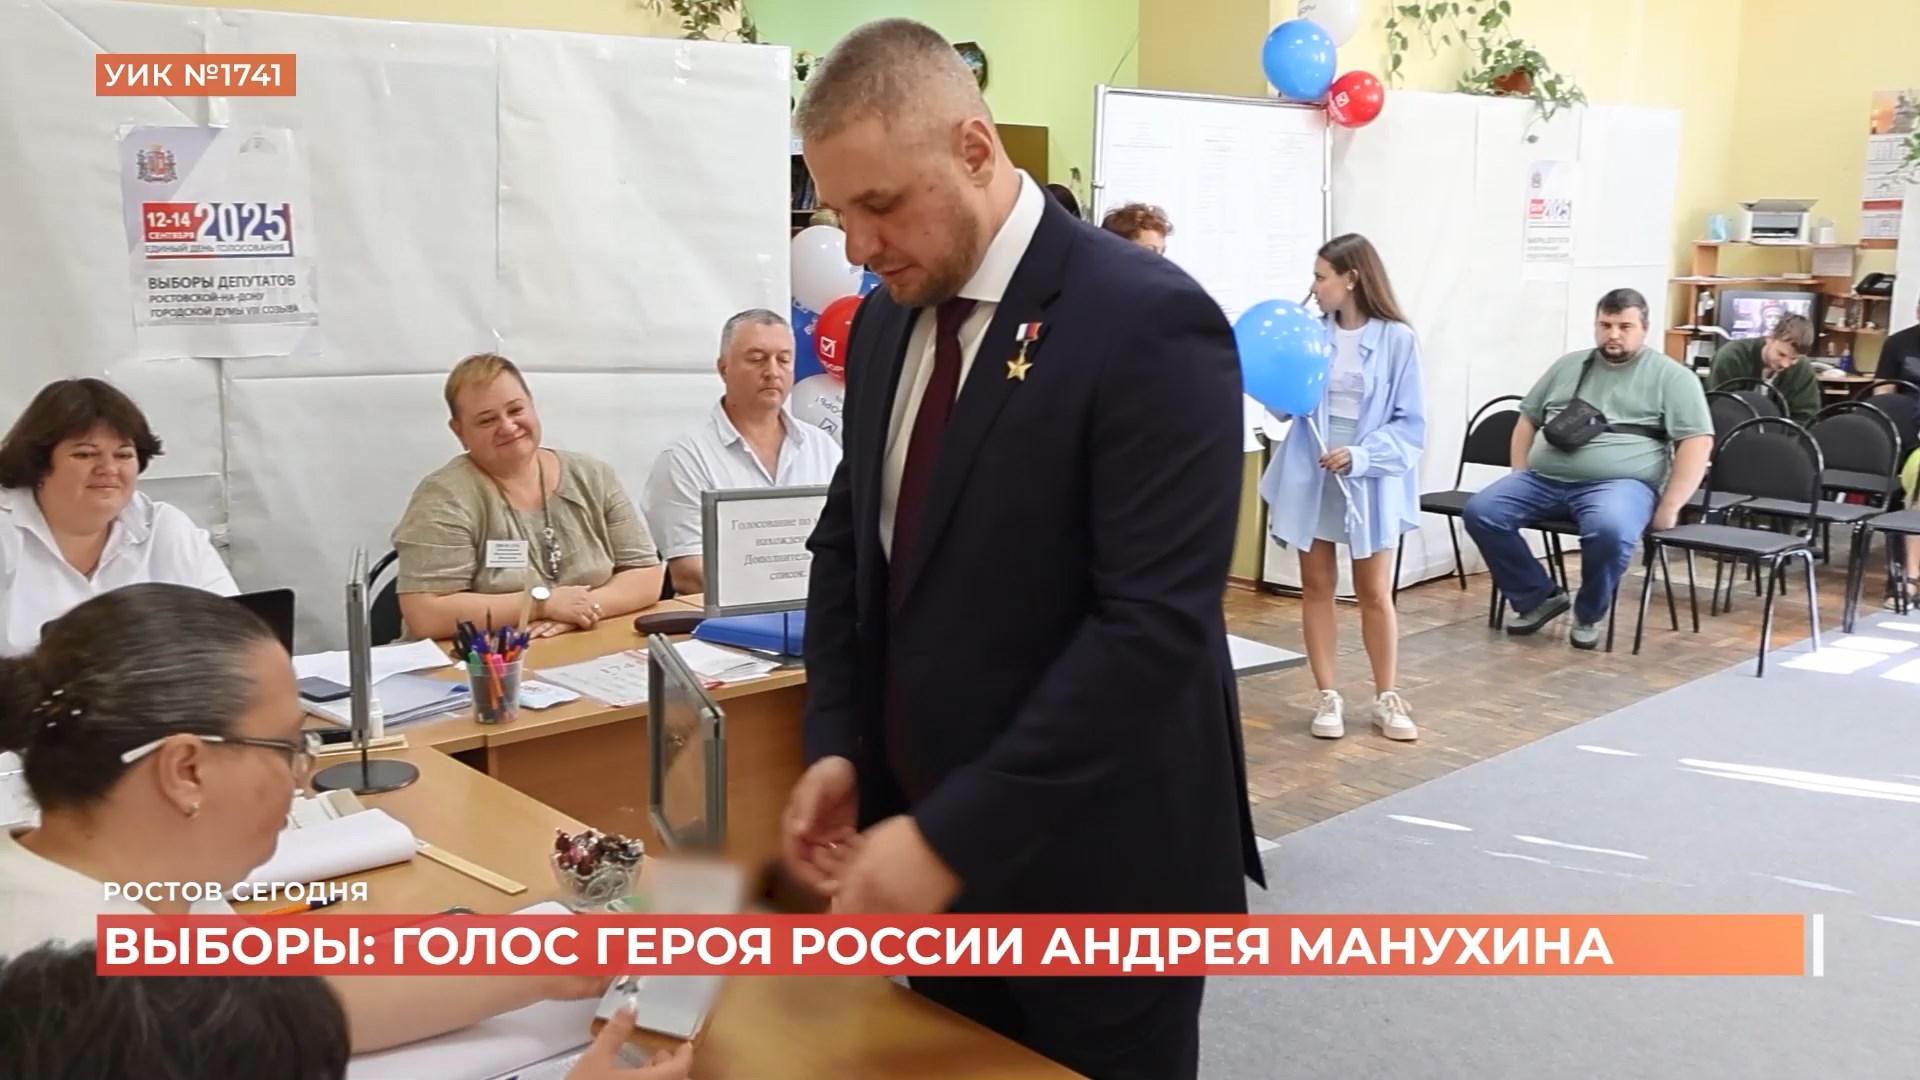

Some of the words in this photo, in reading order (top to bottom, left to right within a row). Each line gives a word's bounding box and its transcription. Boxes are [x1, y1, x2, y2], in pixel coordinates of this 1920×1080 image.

[147, 211, 191, 228] 12-14
[194, 202, 287, 242] 2025
[148, 277, 214, 289] ВЫБОРЫ
[217, 275, 296, 290] ДЕПУТАТОВ
[150, 307, 212, 318] ГОРОДСКОЙ
